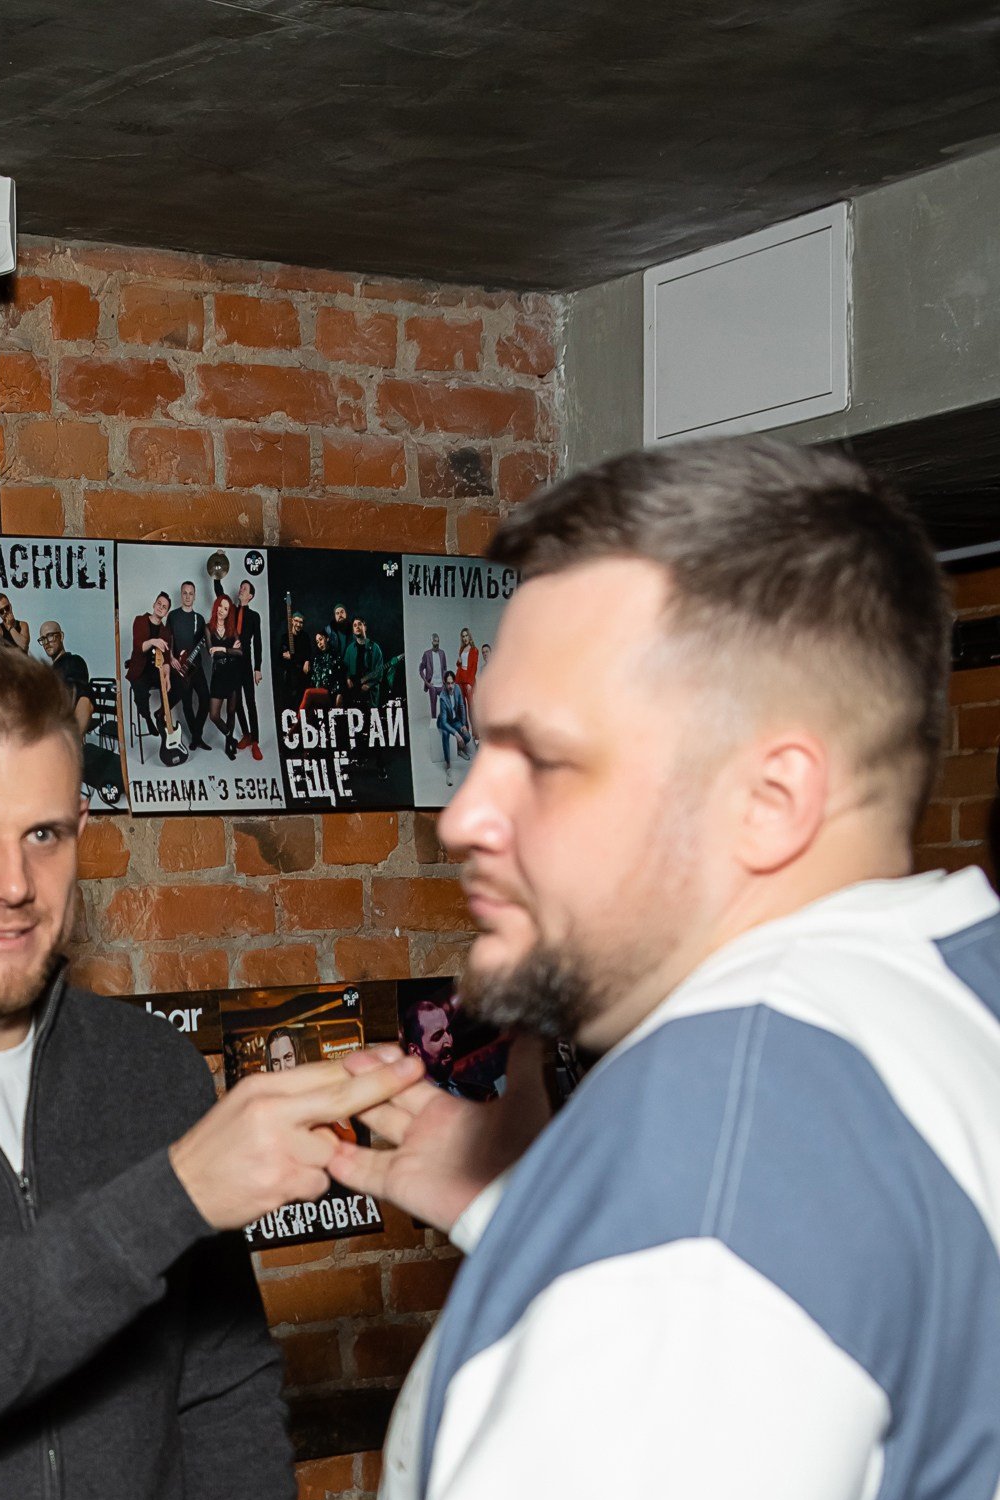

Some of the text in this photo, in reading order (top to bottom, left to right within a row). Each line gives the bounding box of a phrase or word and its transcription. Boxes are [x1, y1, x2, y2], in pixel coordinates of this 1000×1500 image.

[281, 697, 406, 749] СЫГРАЙ
[234, 777, 284, 805] БЭНД
[286, 751, 353, 807] ЕЩЁ
